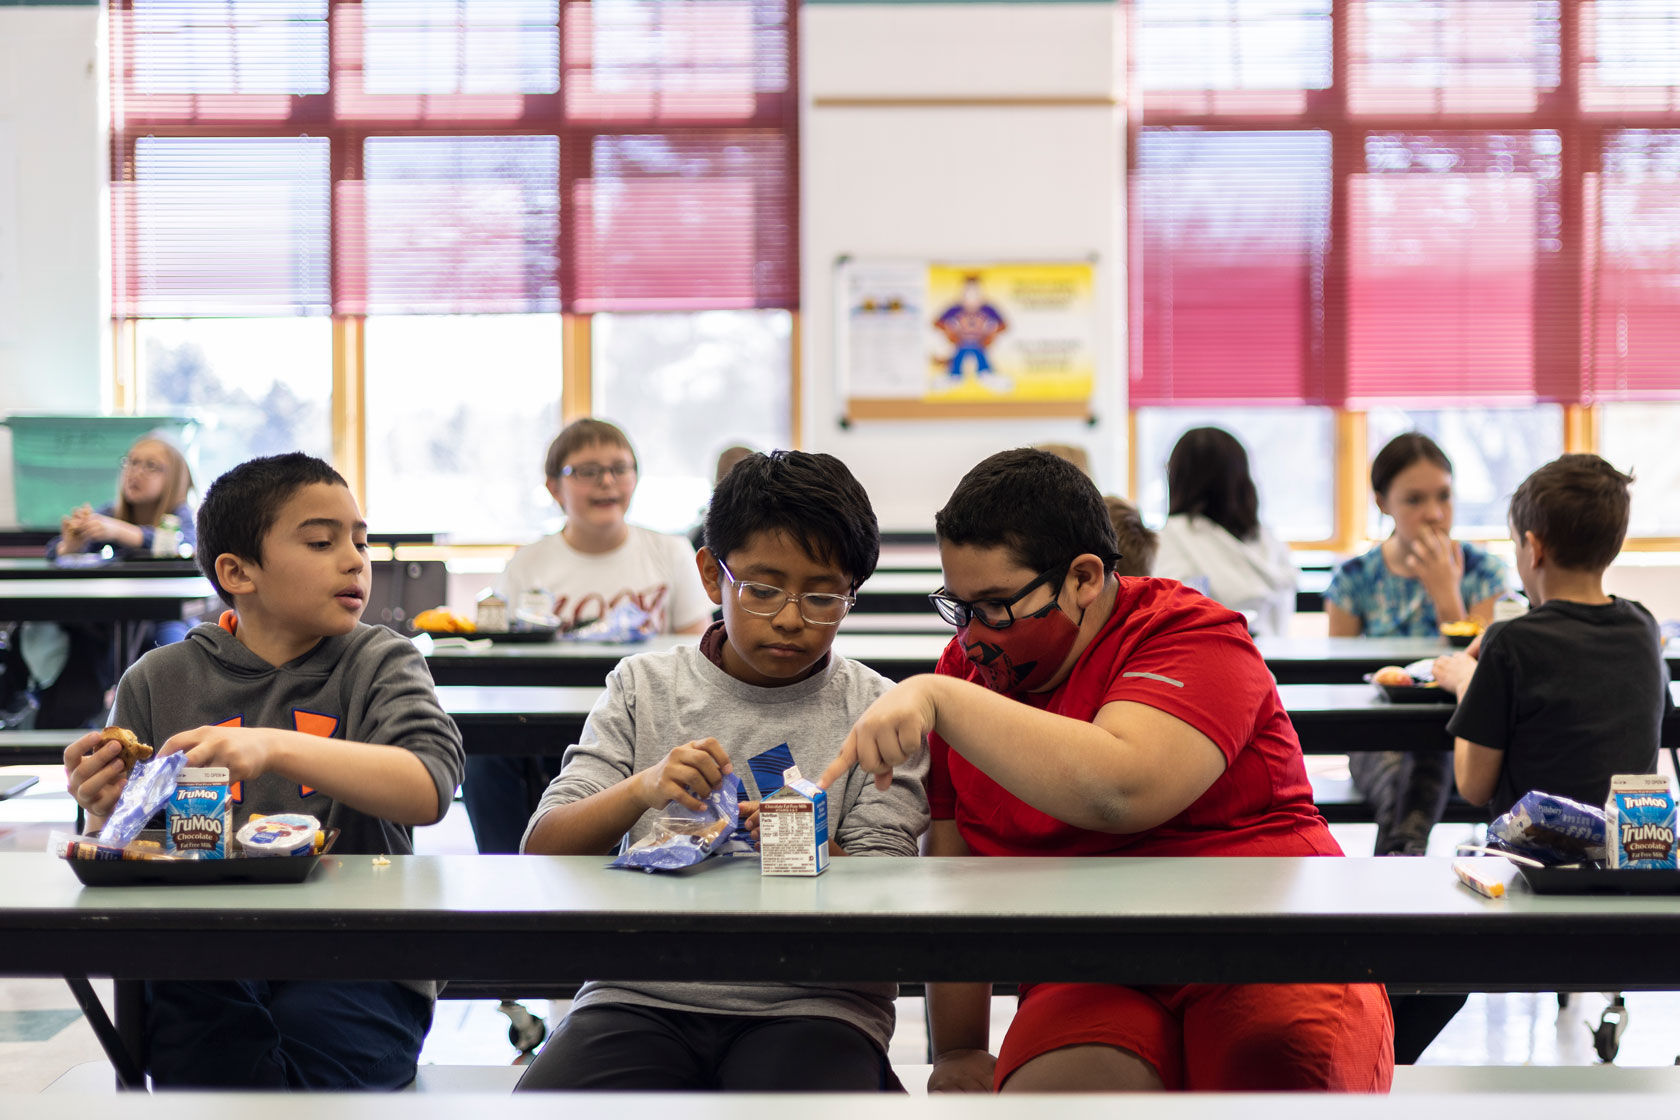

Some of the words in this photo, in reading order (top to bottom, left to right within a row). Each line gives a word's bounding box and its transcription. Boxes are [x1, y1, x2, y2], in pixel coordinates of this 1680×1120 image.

[177, 789, 218, 800] TruMoo
[1623, 797, 1667, 809] TruMoo
[170, 815, 222, 834] TruMoo
[1562, 814, 1596, 826] mini
[177, 833, 213, 841] Chocolate
[1621, 824, 1674, 844] TruMoo
[1630, 842, 1665, 850] Chocolate
